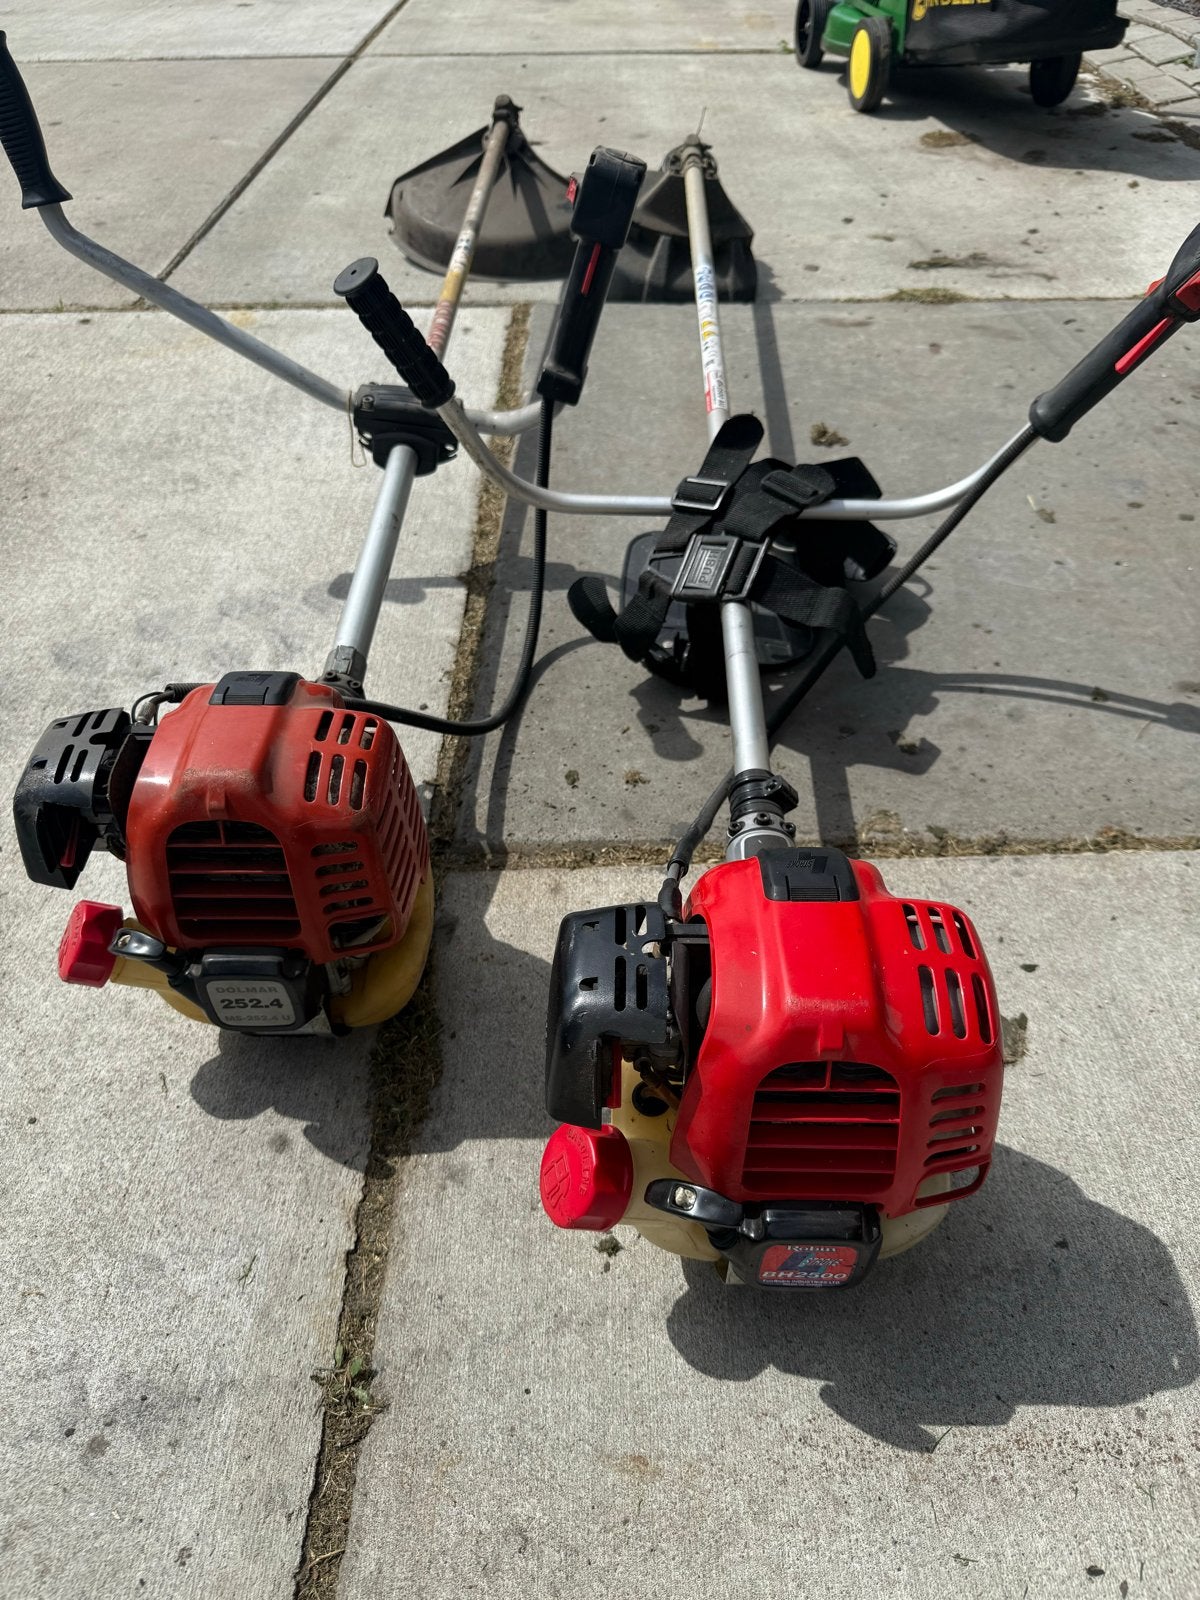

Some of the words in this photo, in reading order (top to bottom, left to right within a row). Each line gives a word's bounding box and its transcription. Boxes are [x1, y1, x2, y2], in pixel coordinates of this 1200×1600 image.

[698, 551, 720, 583] PUSH
[215, 986, 279, 994] DOLMAR
[220, 998, 284, 1009] 252.4
[762, 1271, 848, 1279] BH2500
